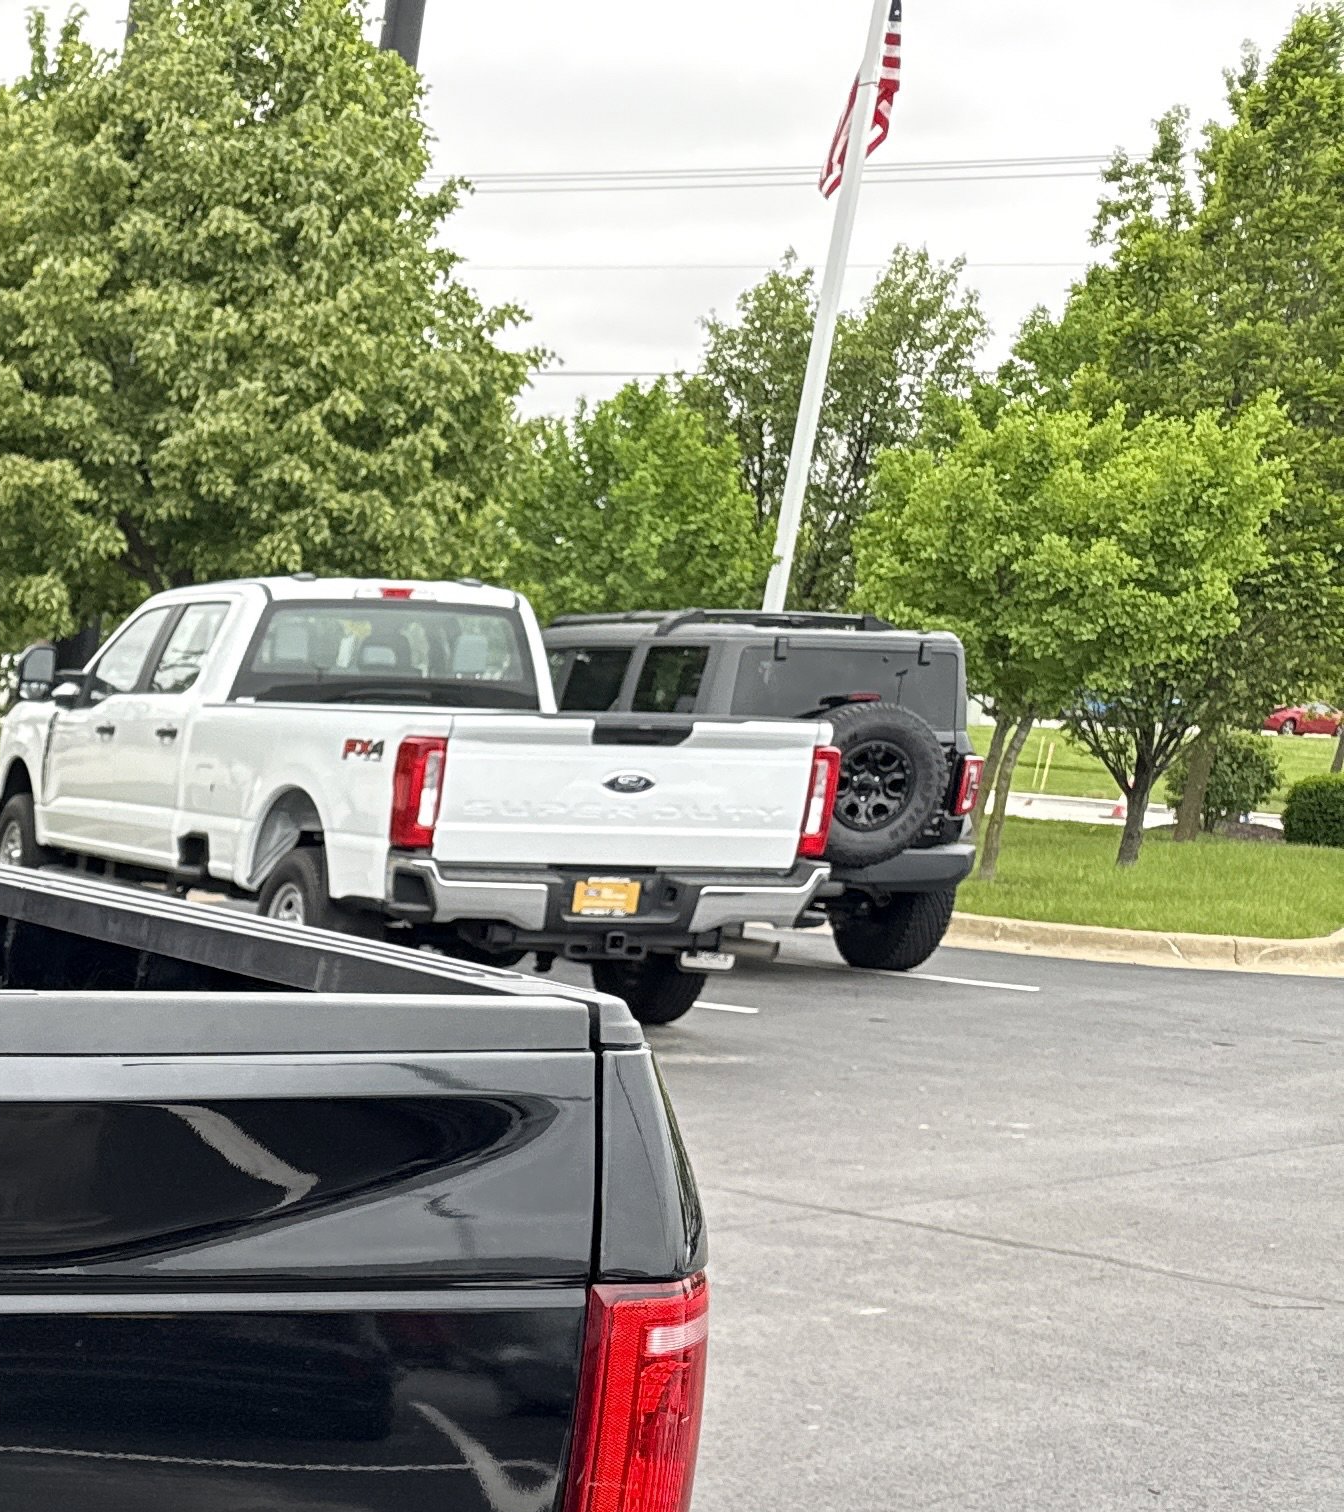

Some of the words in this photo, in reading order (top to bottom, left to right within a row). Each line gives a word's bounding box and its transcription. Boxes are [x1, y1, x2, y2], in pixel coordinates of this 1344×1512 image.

[342, 739, 384, 761] FX4
[463, 800, 641, 819] SUPER
[654, 804, 784, 822] DUTY
